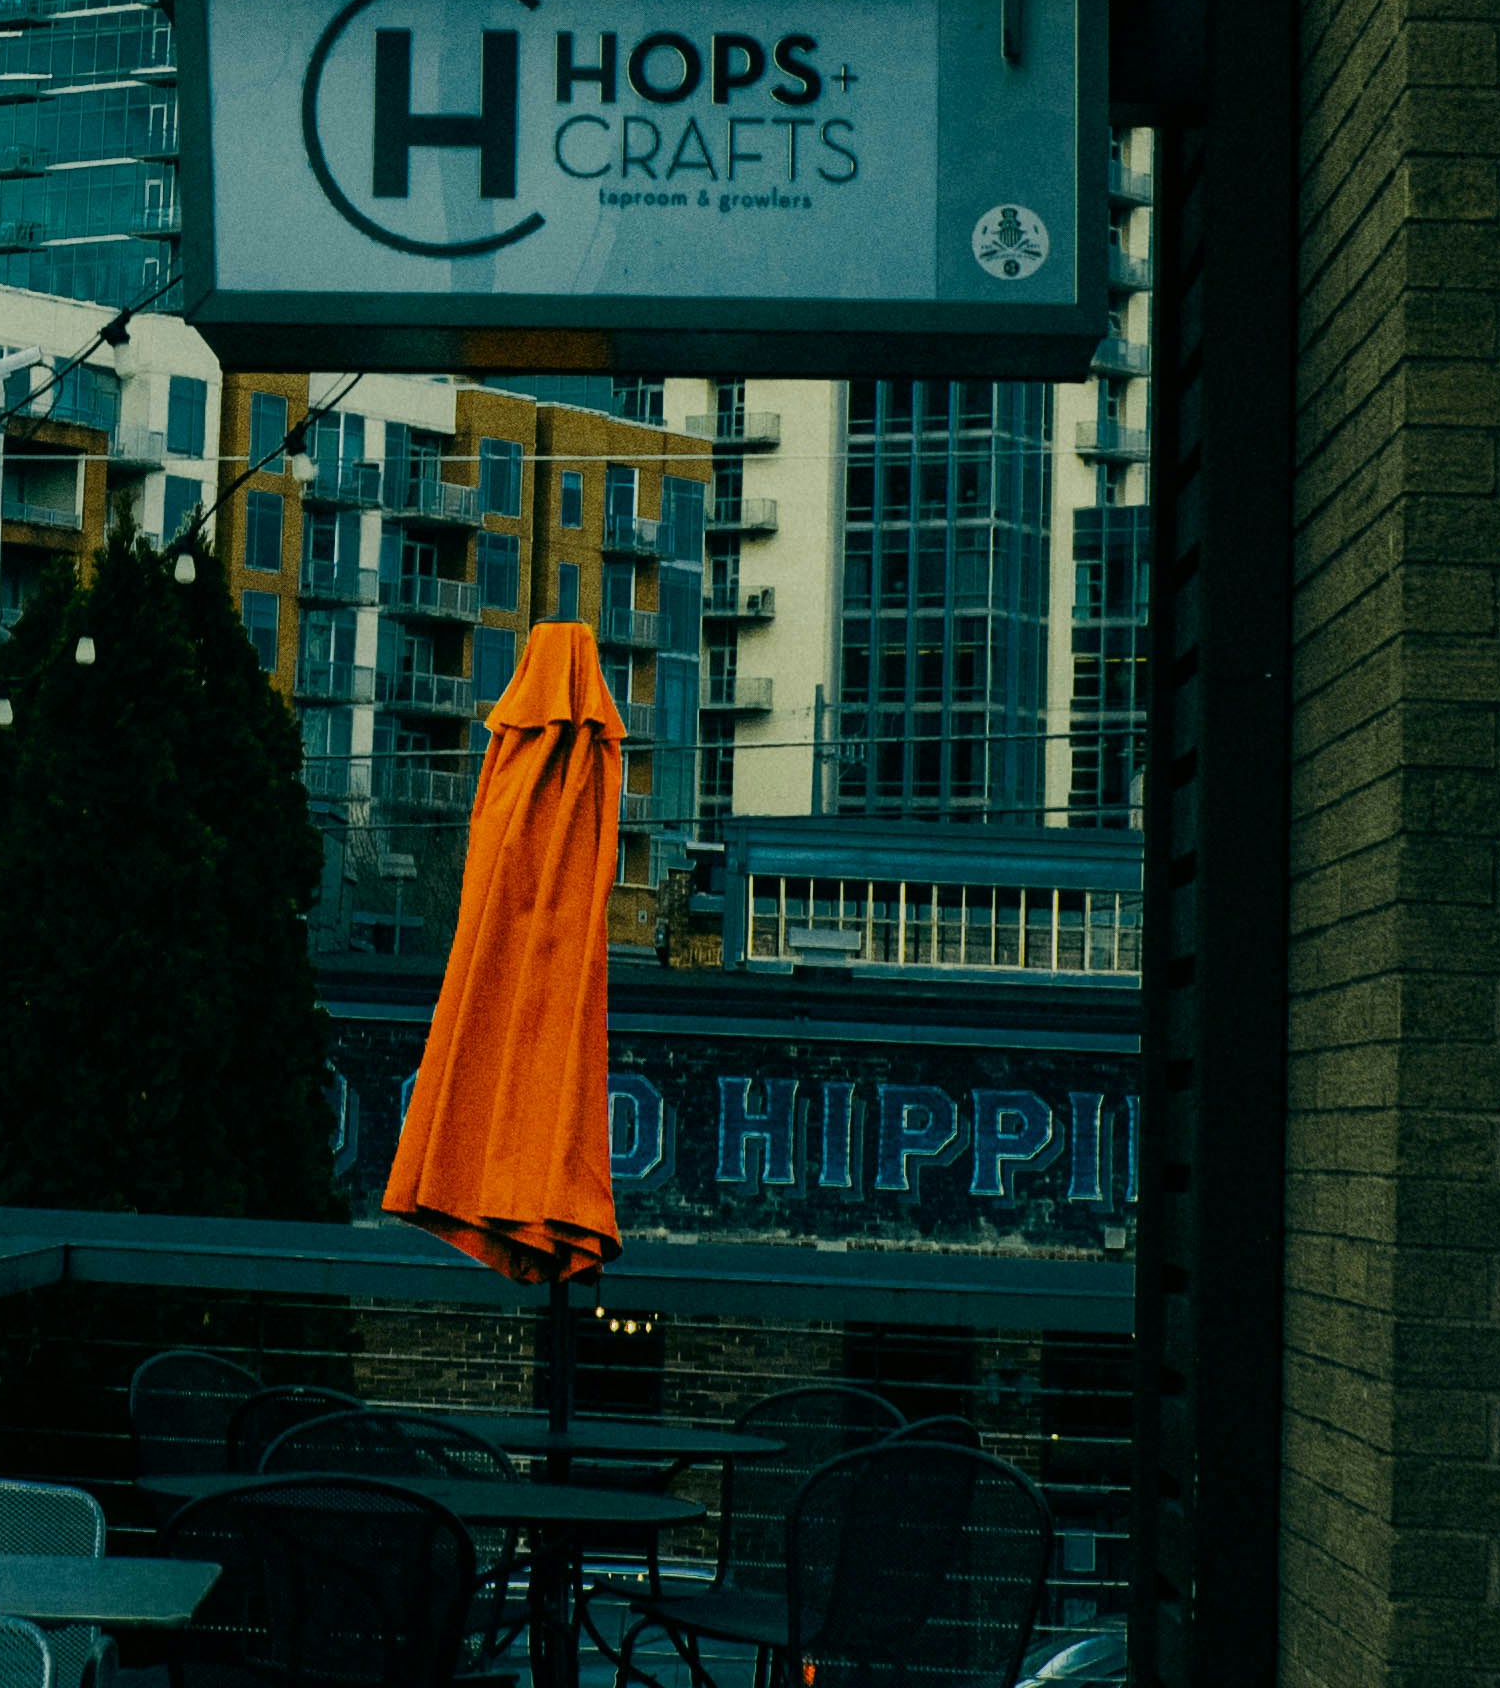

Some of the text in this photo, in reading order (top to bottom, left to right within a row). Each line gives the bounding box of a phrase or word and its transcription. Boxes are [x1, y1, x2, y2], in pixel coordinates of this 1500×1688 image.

[554, 114, 860, 183] CRAFTS
[599, 186, 814, 213] taproom & growlers
[715, 1075, 1140, 1204] HIPPI
